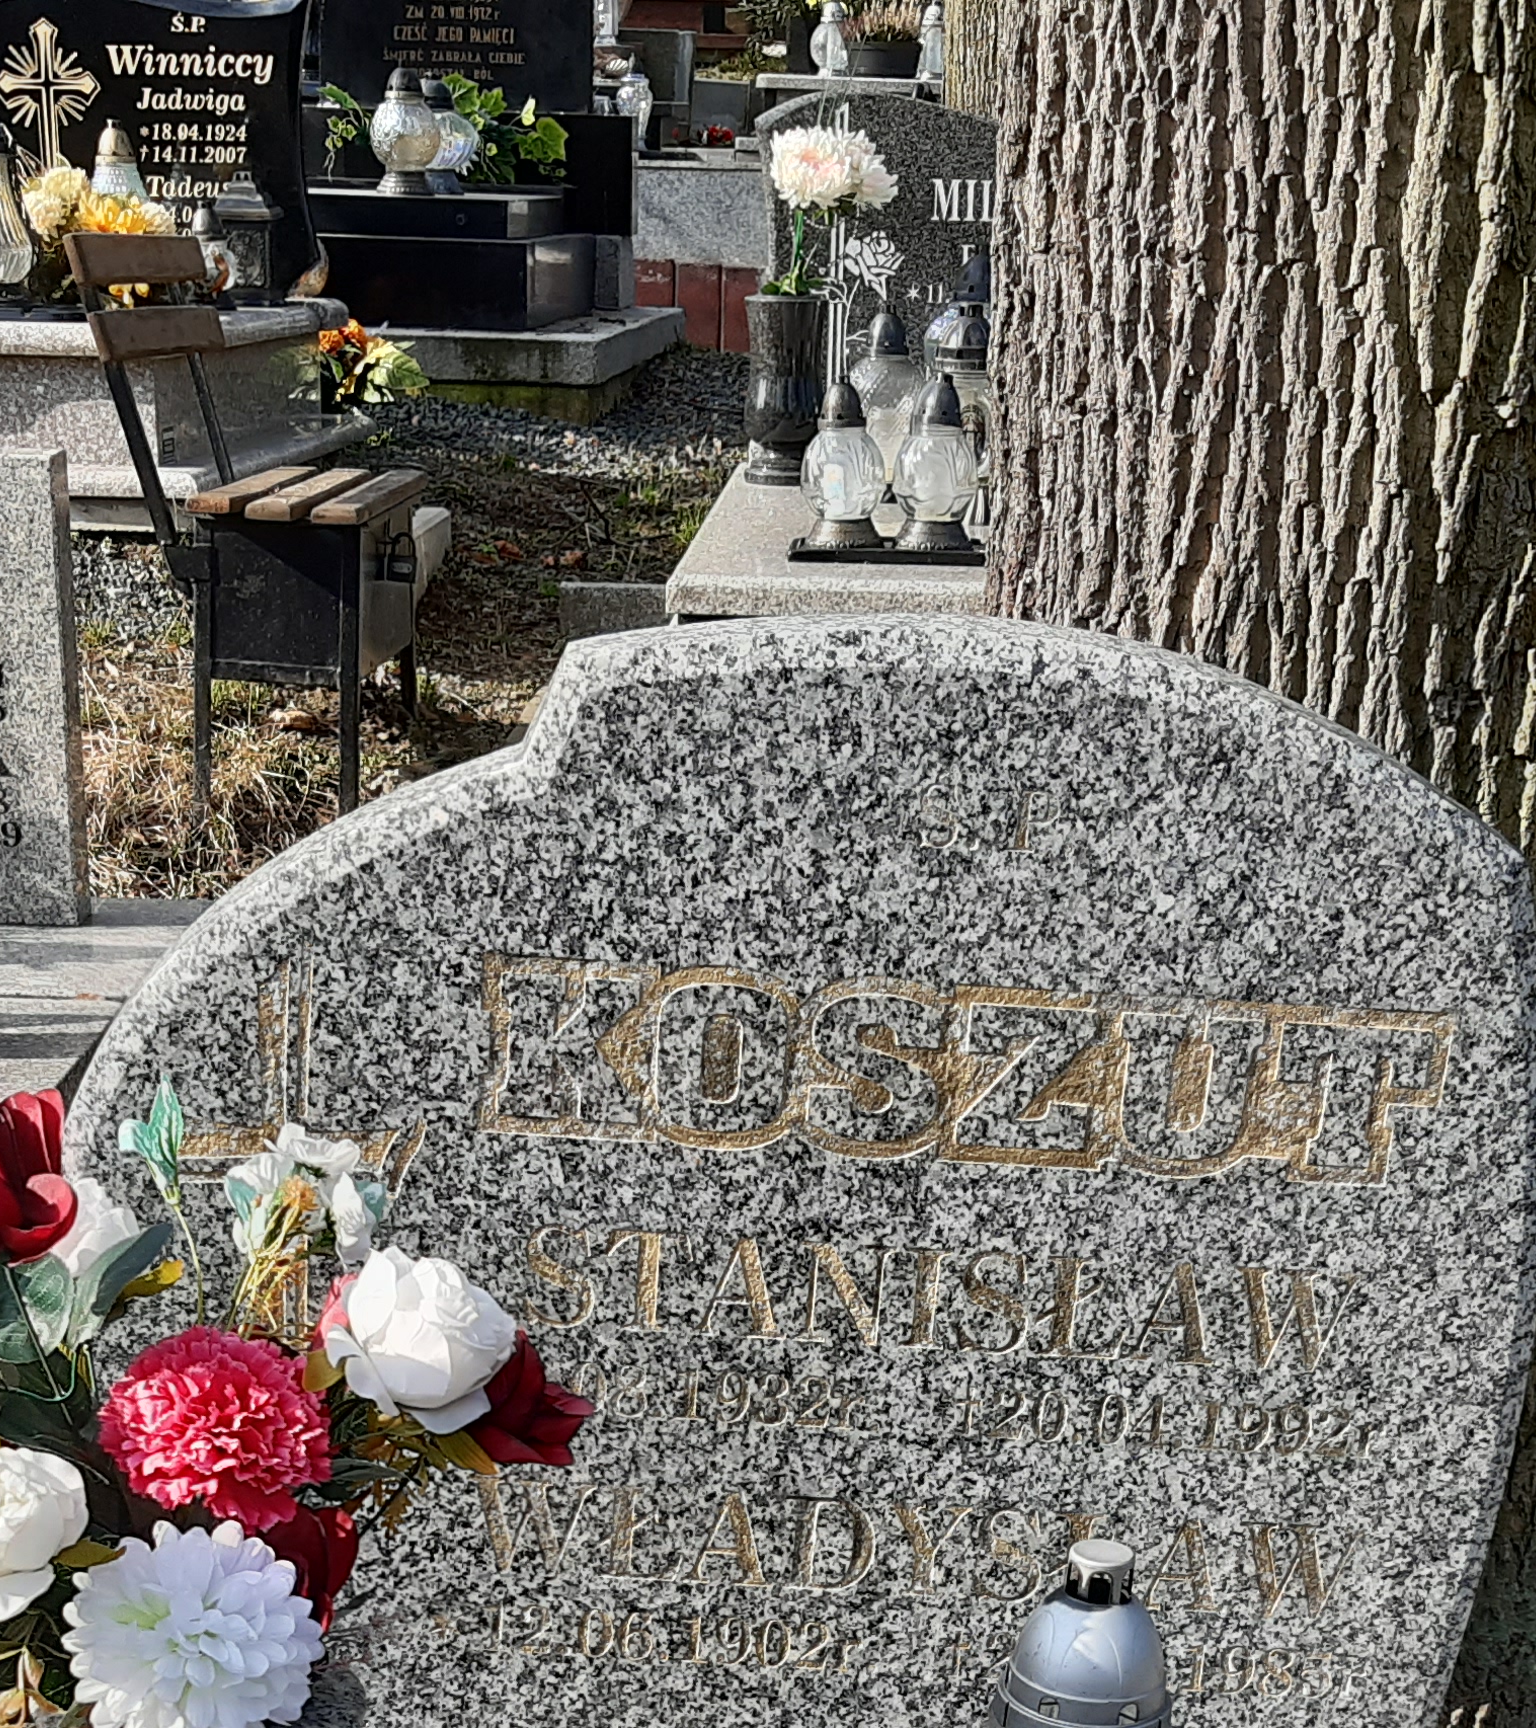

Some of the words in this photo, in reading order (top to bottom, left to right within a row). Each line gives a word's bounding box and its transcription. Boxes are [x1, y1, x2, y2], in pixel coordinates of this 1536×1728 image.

[170, 12, 206, 33] Ś.P.
[435, 26, 463, 42] JEGO
[470, 27, 515, 46] PAMIĘCI
[105, 44, 274, 84] Winniccy
[136, 87, 246, 116] Jadwiga
[152, 123, 248, 142] 18.04.1924
[152, 146, 247, 164] 14.11.2007
[484, 952, 1454, 1187] KOSZUT
[526, 1224, 1361, 1373] STANISŁAW
